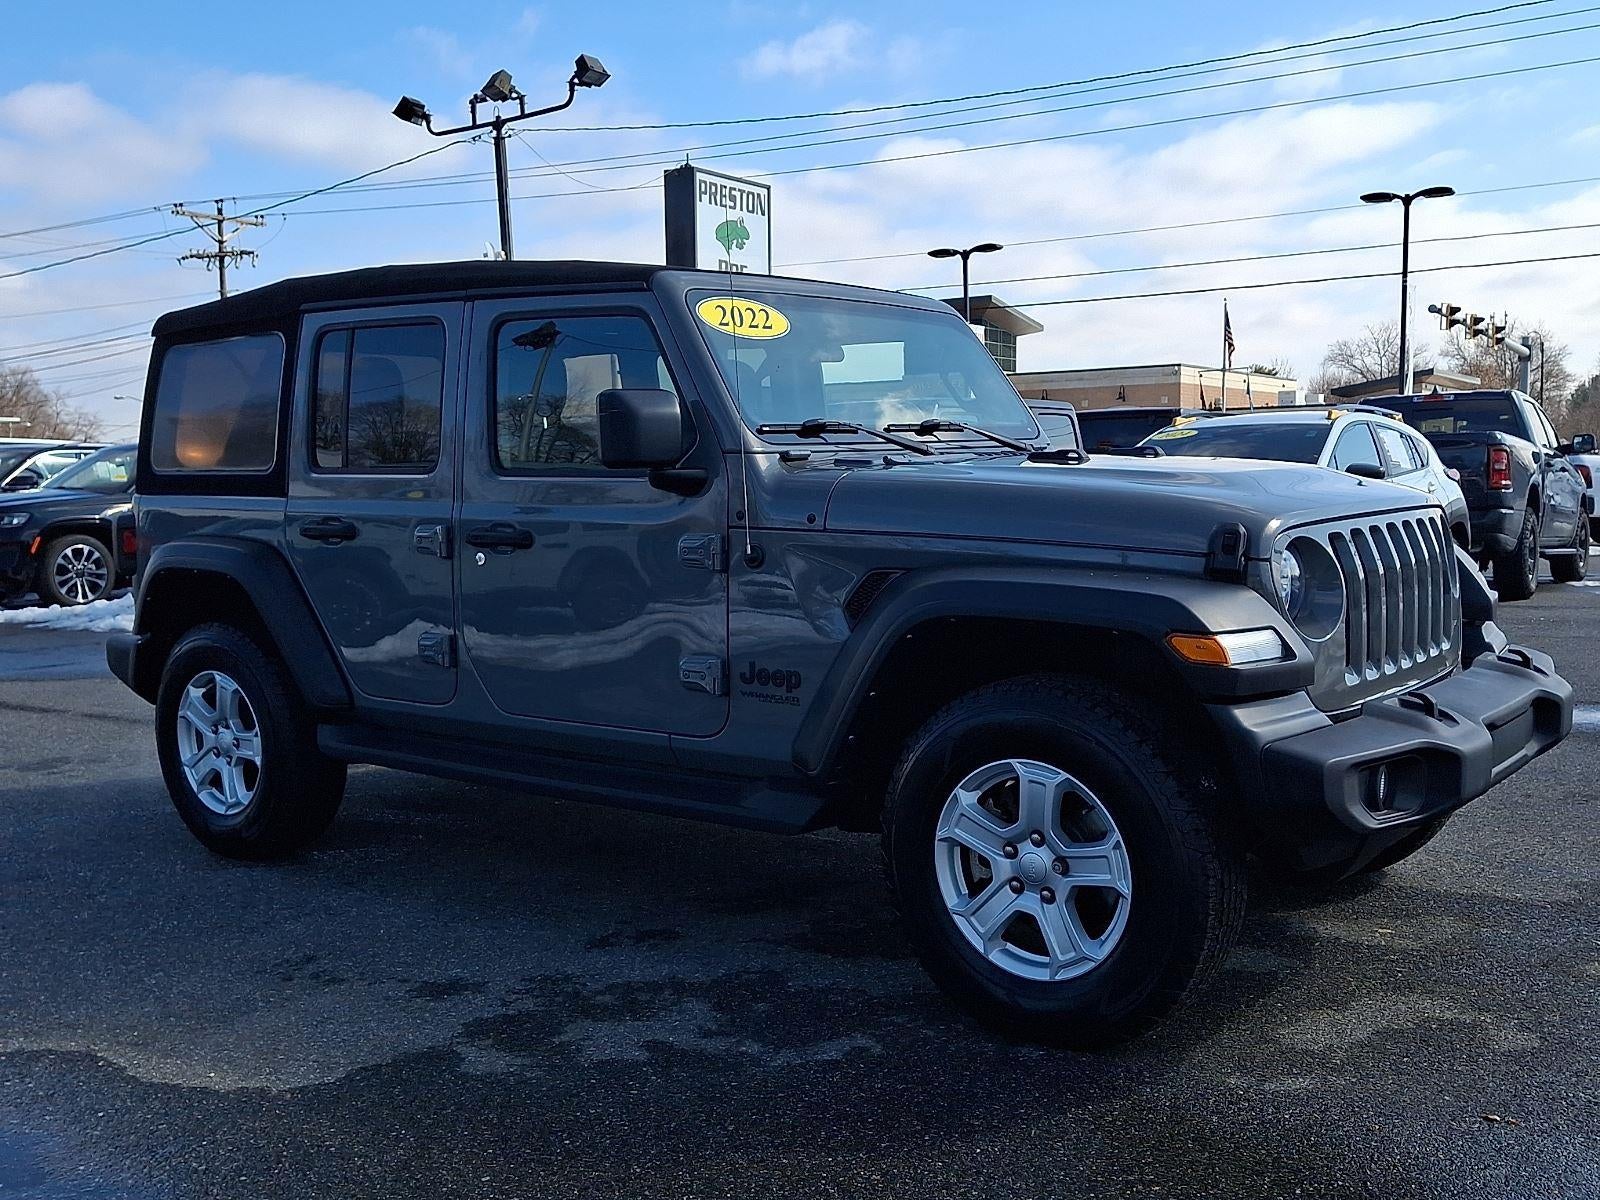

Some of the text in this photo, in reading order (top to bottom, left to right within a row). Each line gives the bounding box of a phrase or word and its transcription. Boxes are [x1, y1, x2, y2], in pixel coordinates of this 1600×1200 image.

[698, 178, 766, 217] PRESTON
[715, 304, 773, 330] 2022
[739, 660, 802, 693] Jeep
